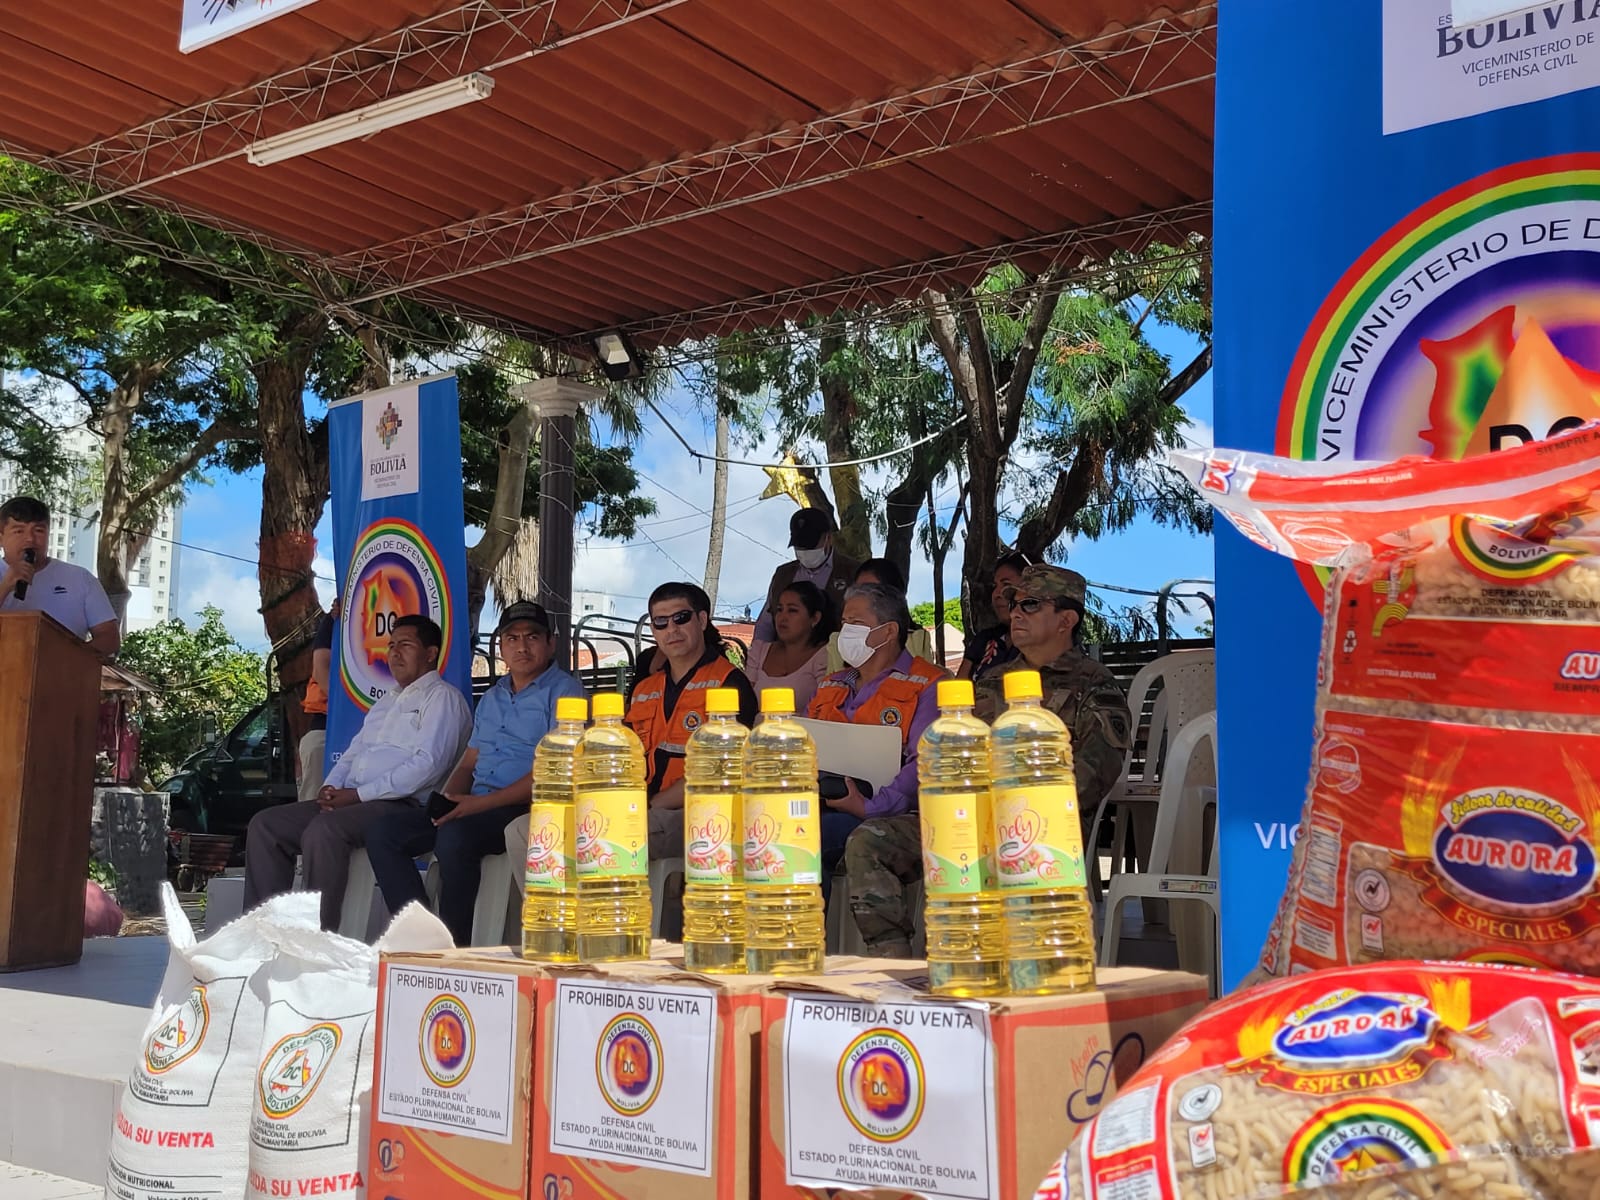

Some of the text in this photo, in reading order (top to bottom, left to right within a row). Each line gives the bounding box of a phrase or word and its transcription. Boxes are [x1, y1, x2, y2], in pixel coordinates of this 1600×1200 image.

[1462, 32, 1595, 75] VICEMINISTERIO DE
[1479, 53, 1578, 87] DEFENSA CIVIL
[1321, 232, 1509, 461] VICEMINISTERIO
[1521, 219, 1572, 245] DE
[370, 458, 407, 476] BOLIVIA
[1488, 544, 1548, 560] BOLIVIA
[383, 541, 394, 549] DE
[396, 541, 430, 577] DEFENSA
[427, 578, 440, 614] CIVIL
[1471, 597, 1549, 608] PLURINACIONAL
[1551, 600, 1567, 609] DE
[1481, 588, 1553, 599] DEFENSA CIVIL
[1501, 608, 1568, 619] HUMANITARIA
[1514, 795, 1581, 832] calidad
[1446, 836, 1575, 874] AURORA
[1455, 908, 1572, 941] ESPECIALES
[397, 973, 505, 998] PROHIBIDA SU VENTA
[428, 1002, 466, 1023] DEFENSA CIVIL
[568, 990, 700, 1016] PROHIBIDA SU VENTA
[803, 1004, 974, 1029] PROHIBIDA SU VENTA
[607, 1022, 653, 1043] DEFENSA CIVIL
[441, 1037, 452, 1050] DC
[850, 1038, 911, 1065] DEFENSA CIVIL
[622, 1060, 636, 1074] DC
[871, 1081, 889, 1097] DC
[1294, 1063, 1421, 1094] ESPECIALES
[266, 1093, 301, 1111] BOLIVIA
[421, 1087, 468, 1103] DEFENSA CIVIL
[616, 1098, 641, 1108] BOLIVIA
[389, 1093, 502, 1121] ESTADO PLURINACIONAL DE BOLIVIA
[412, 1107, 476, 1126] AYUDA HUMANITARIA
[276, 1122, 290, 1131] CIVIL
[297, 1128, 327, 1139] BOLIVIA
[600, 1116, 656, 1133] DEFENSA CIVIL
[866, 1122, 898, 1133] BOLIVIA
[135, 1127, 153, 1145] SU
[157, 1130, 215, 1148] VENTA
[261, 1136, 299, 1147] HUMANITARIA
[561, 1121, 698, 1153] ESTADO PLURINACIONAL DE BOLIVIA
[589, 1138, 668, 1160] AYUDA HUMANITARIA
[848, 1143, 921, 1161] DEFENSA CIVIL
[1311, 1124, 1418, 1176] DEFENSA CIVIL
[799, 1150, 977, 1181] ESTADO PLURINACIONAL DE BOLIVIA
[127, 1174, 175, 1190] NUTRICIONAL
[269, 1178, 292, 1197] SU
[297, 1171, 365, 1197] VENTA
[835, 1167, 937, 1190] AYUDA HUMANITARIA
